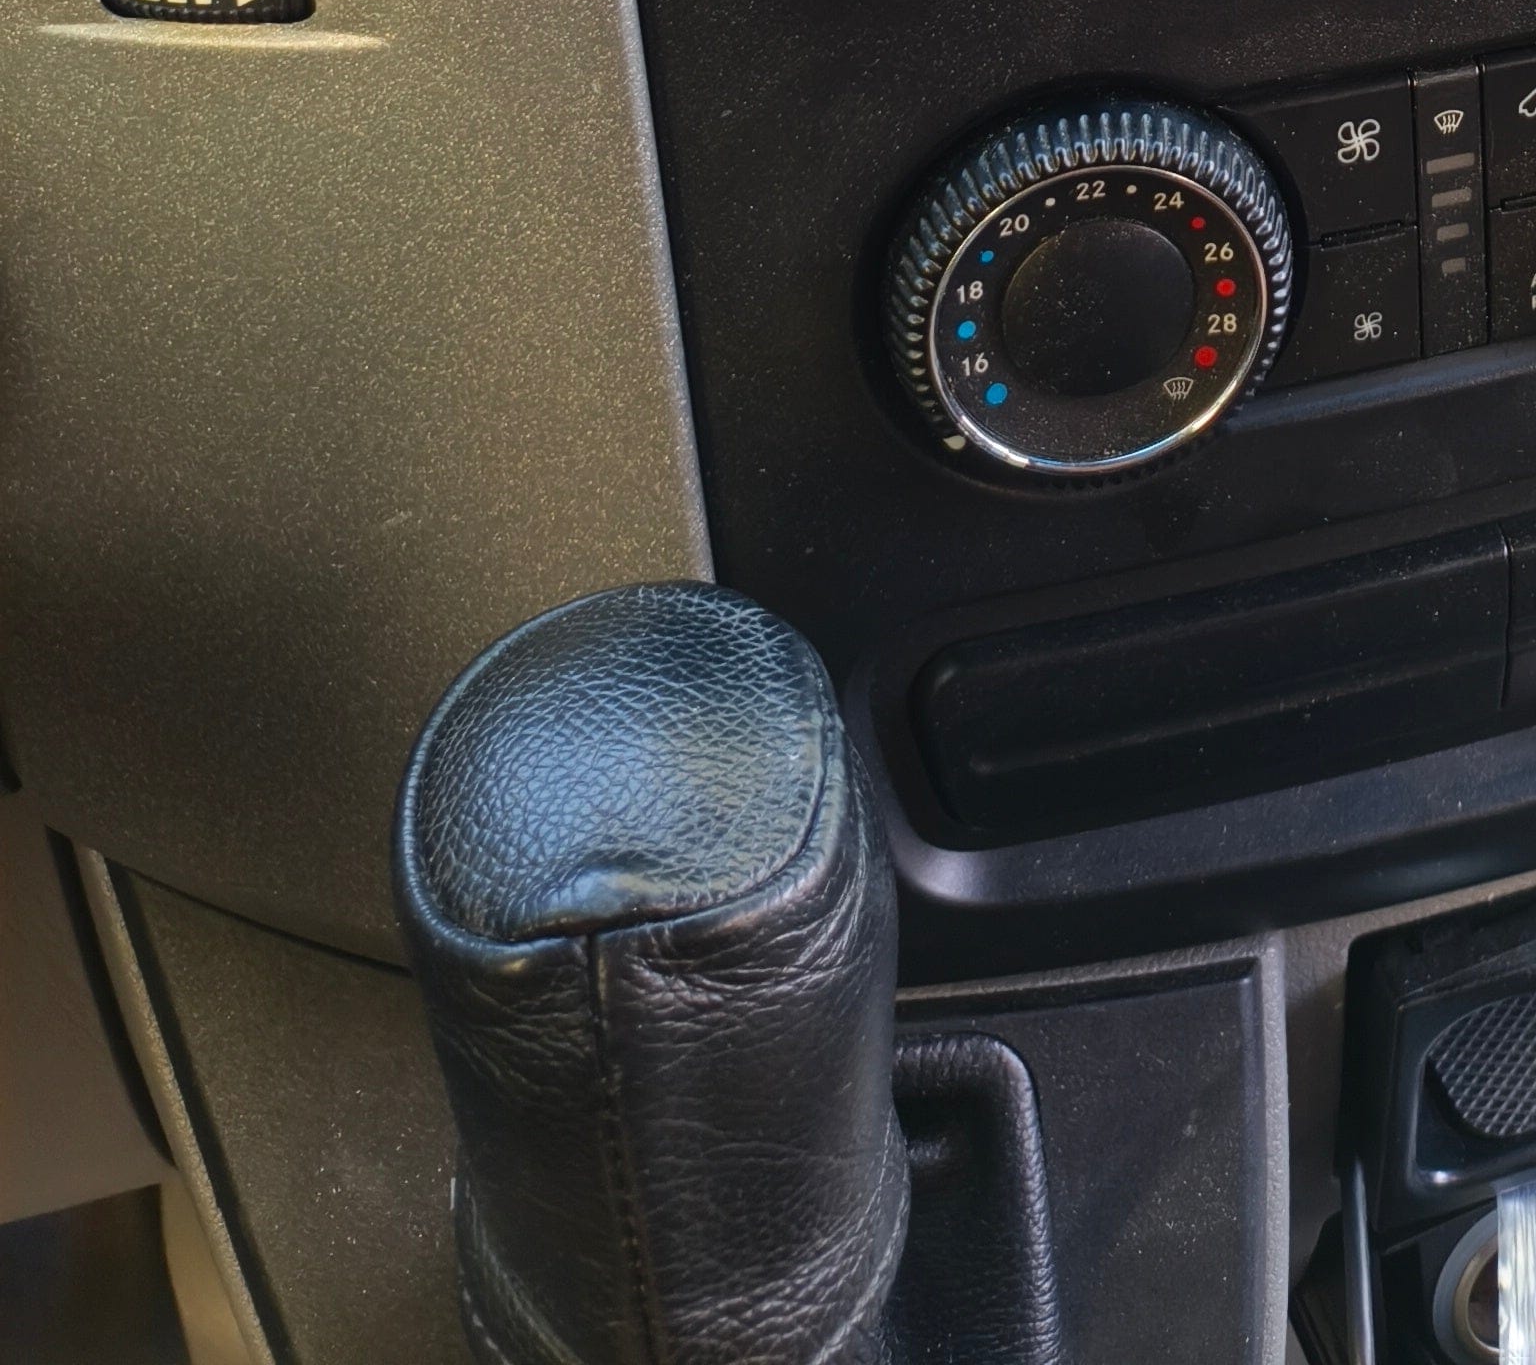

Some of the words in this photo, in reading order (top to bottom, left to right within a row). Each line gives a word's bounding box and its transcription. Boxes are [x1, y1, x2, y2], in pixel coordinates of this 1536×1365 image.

[1075, 180, 1107, 202] 22
[1153, 191, 1185, 211] 24
[1000, 214, 1030, 238] 20
[1204, 242, 1235, 263] 26
[955, 280, 984, 304] 18
[1207, 313, 1238, 335] 28
[961, 352, 989, 377] 16
